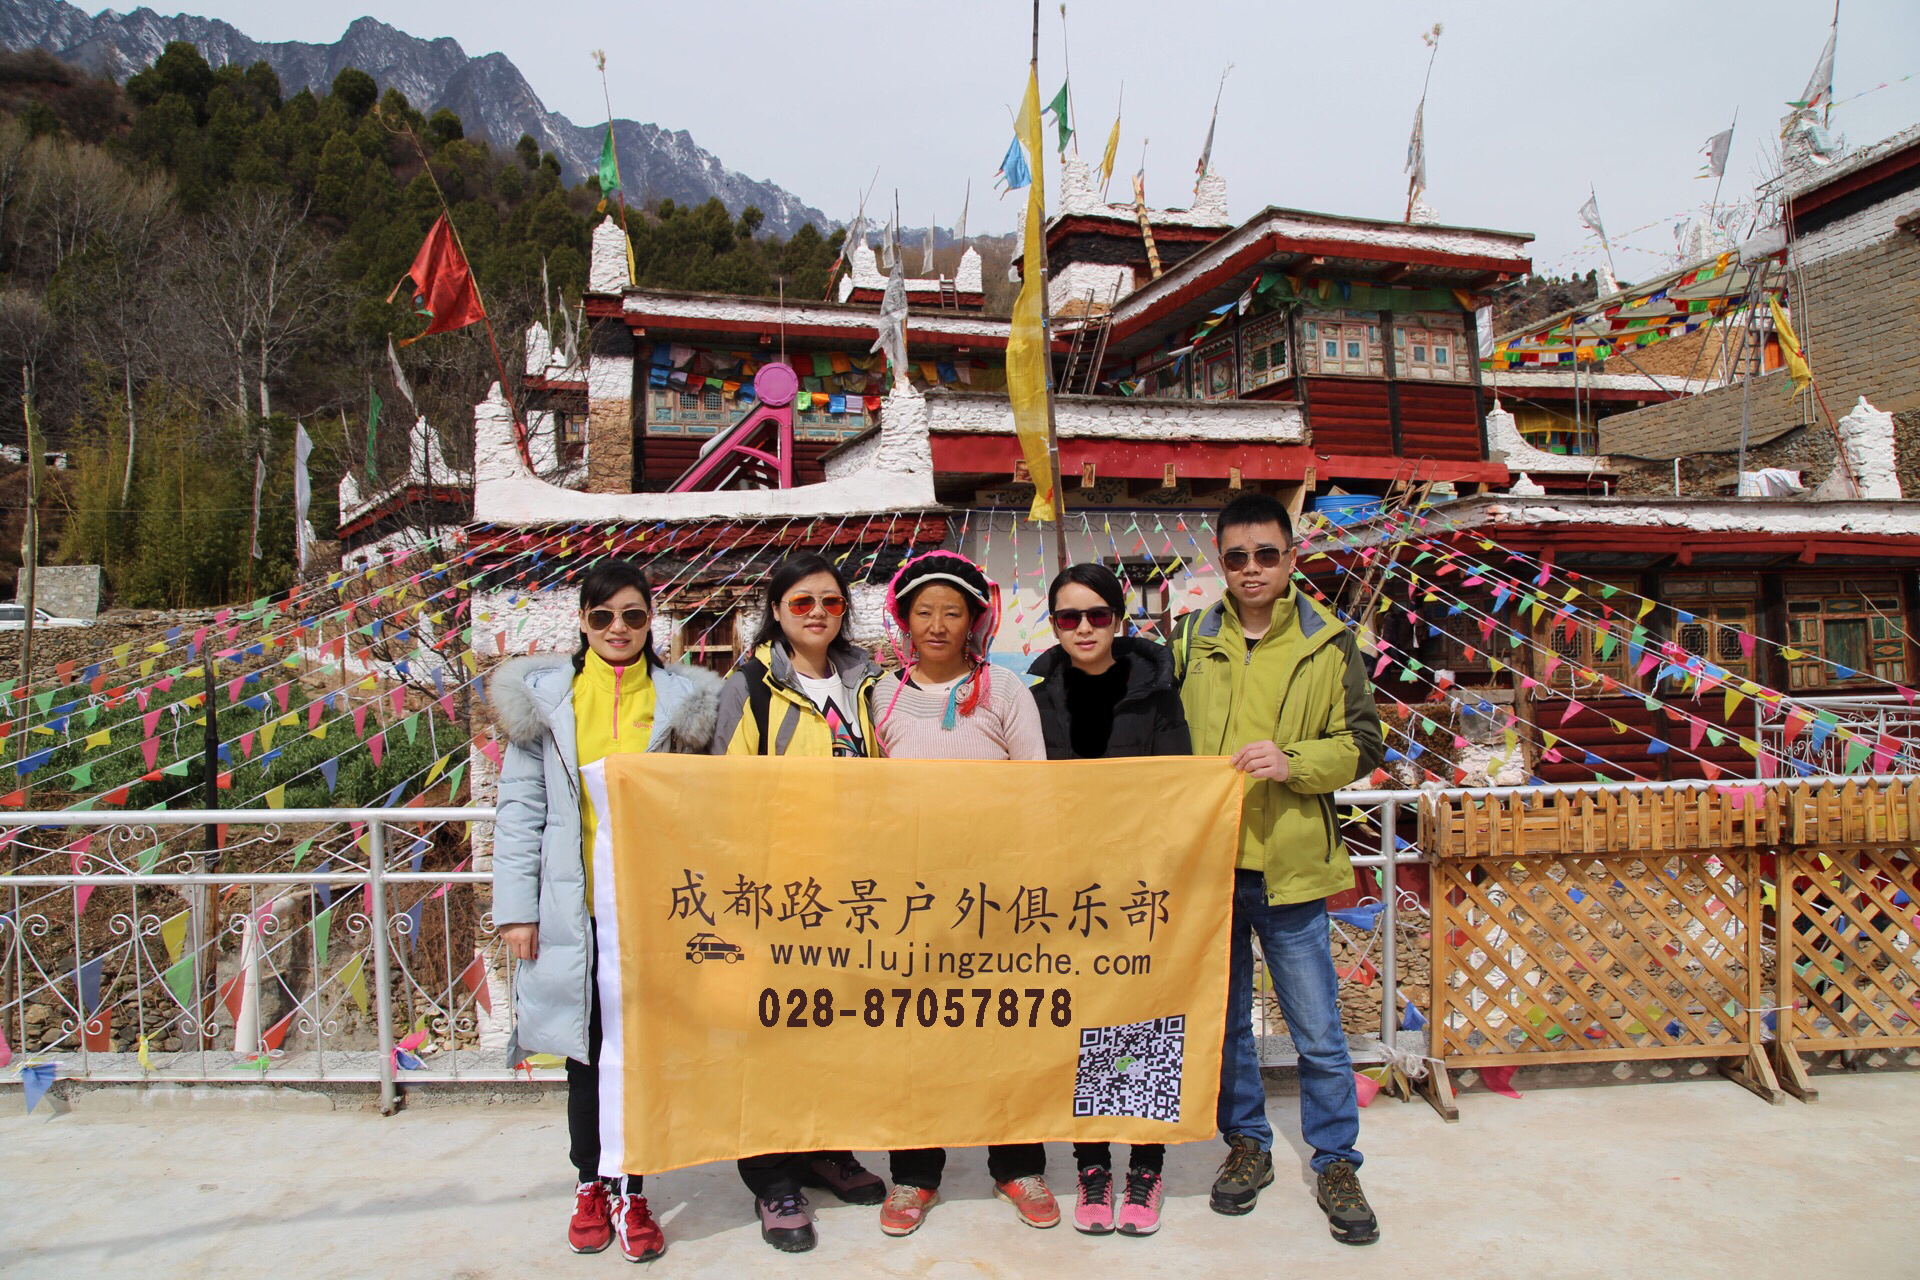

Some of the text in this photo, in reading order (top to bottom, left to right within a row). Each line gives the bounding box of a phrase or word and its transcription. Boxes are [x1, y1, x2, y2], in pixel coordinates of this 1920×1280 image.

[668, 868, 1170, 944] 成都路景户外俱乐部
[770, 940, 1152, 979] www.lujingzuche.com
[758, 987, 1072, 1028] 028-87057878
